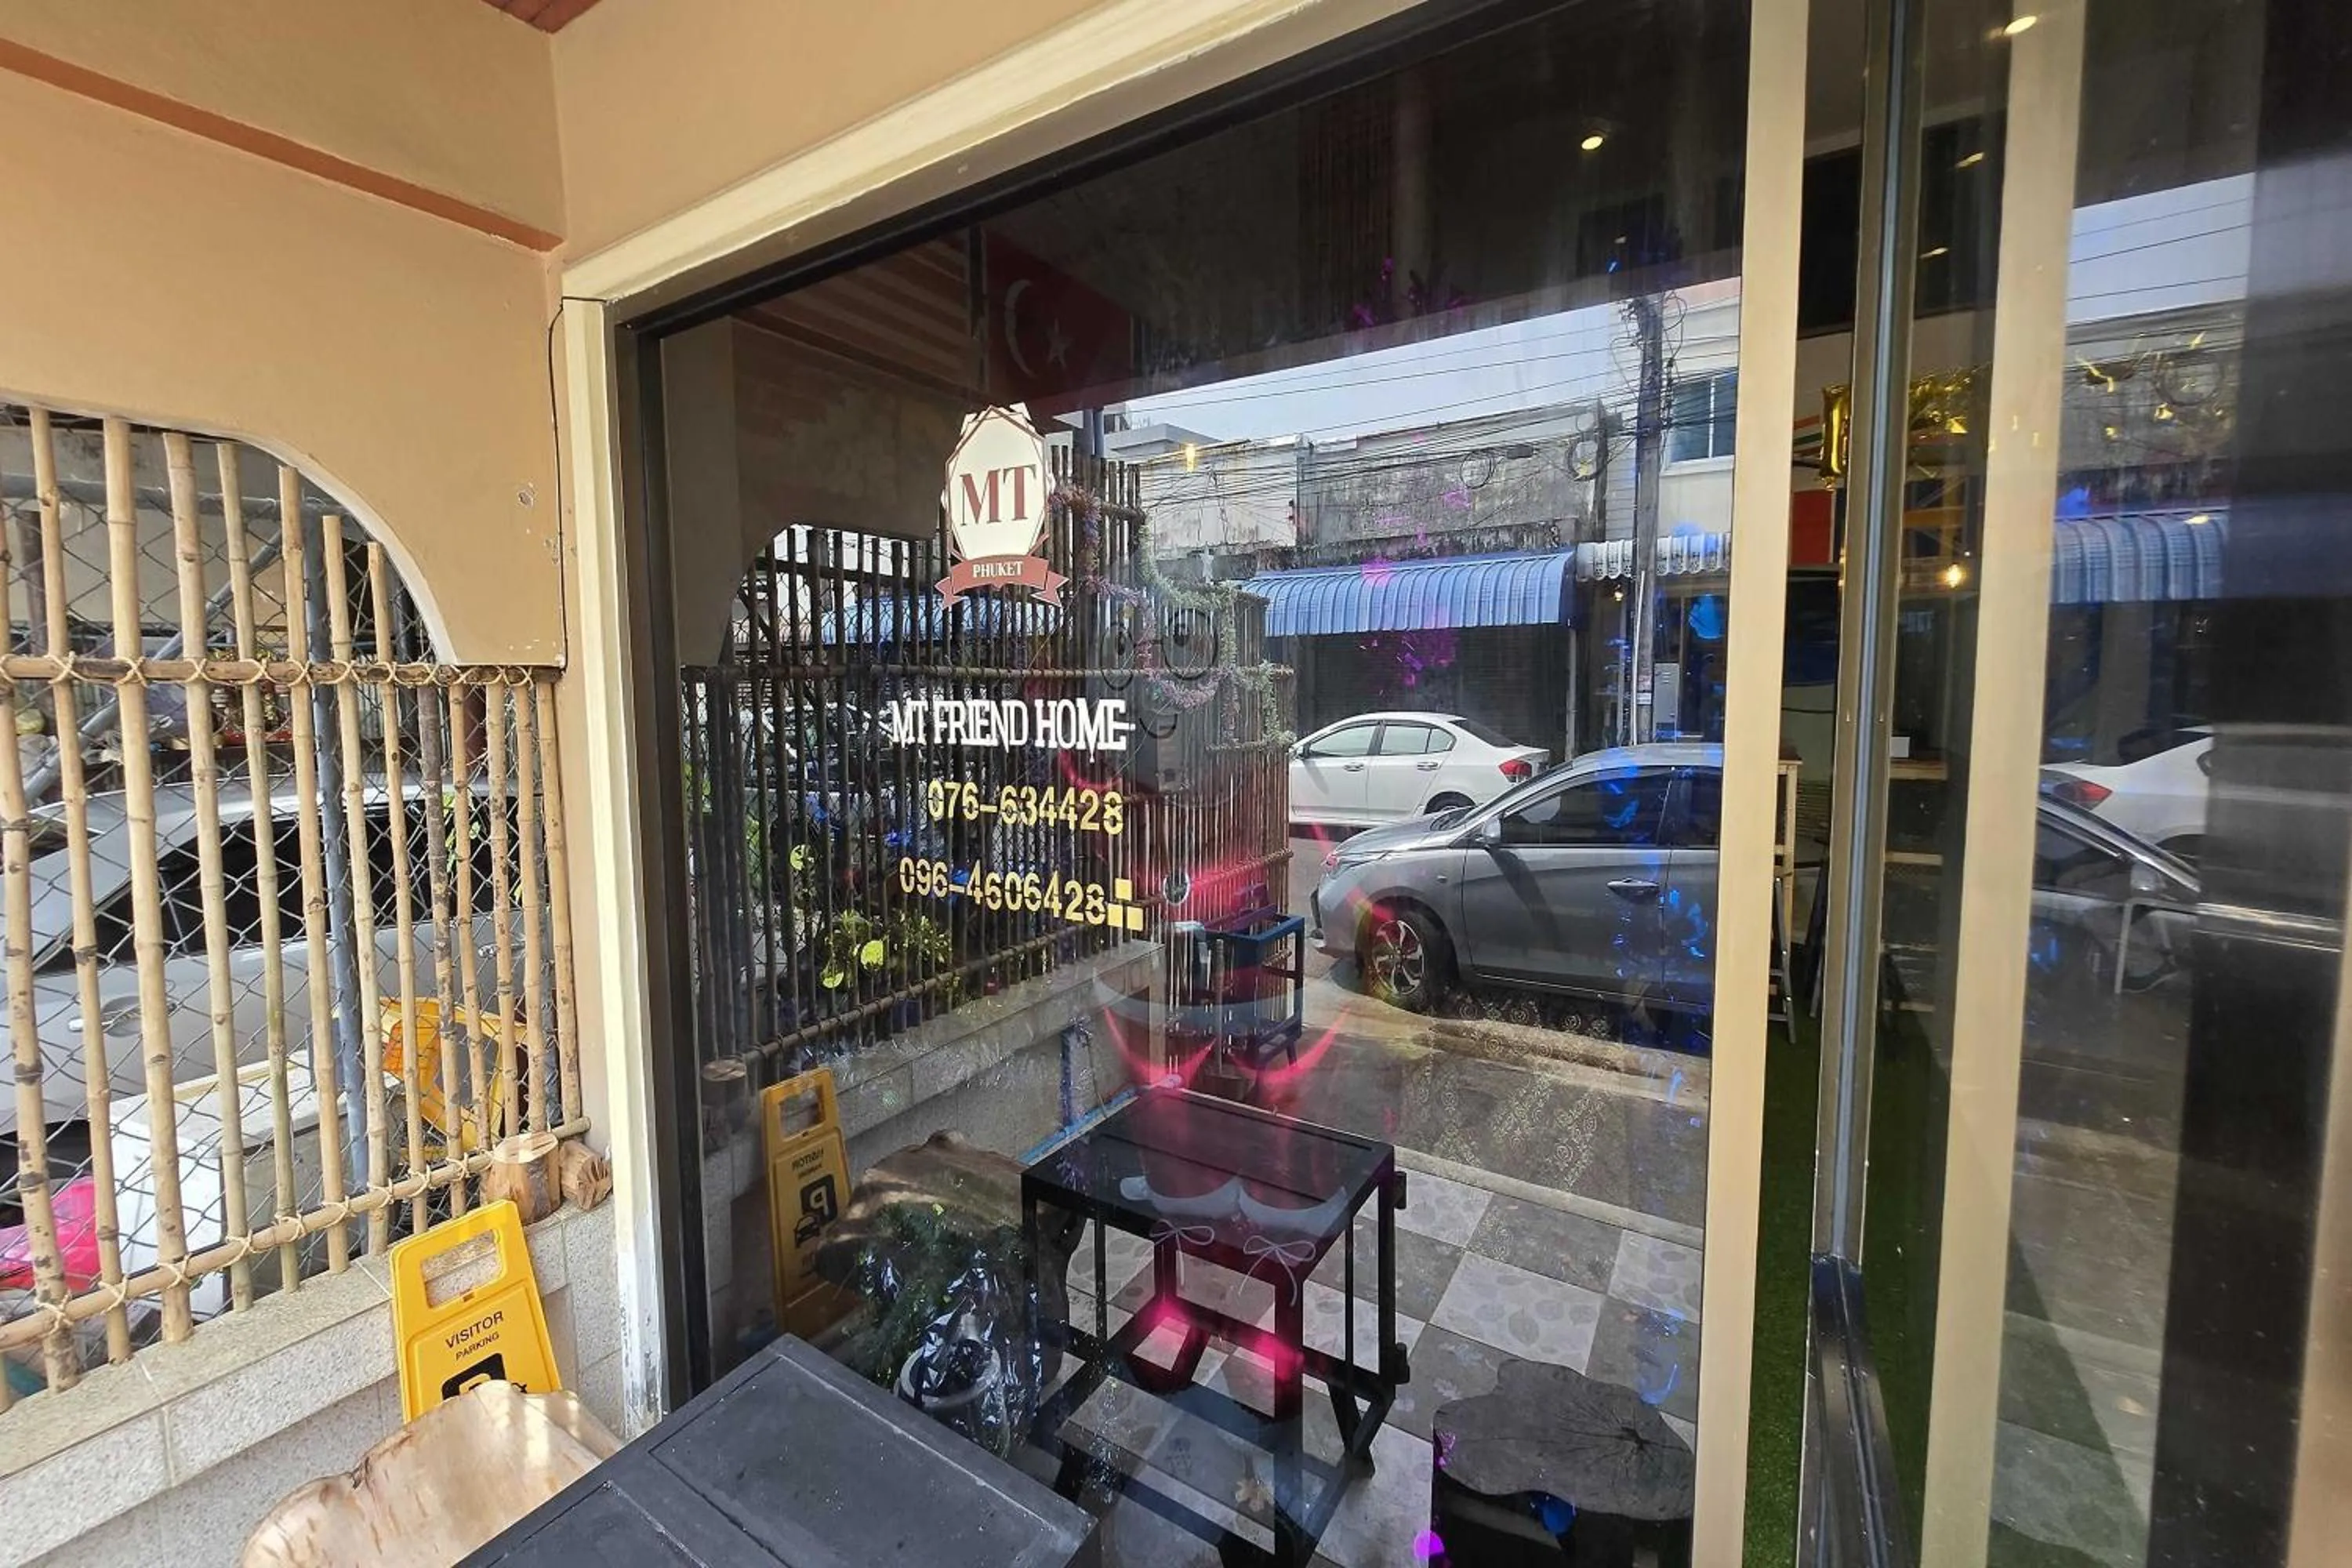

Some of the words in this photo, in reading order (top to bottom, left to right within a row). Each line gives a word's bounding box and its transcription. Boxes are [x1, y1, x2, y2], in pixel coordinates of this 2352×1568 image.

[959, 463, 1037, 526] MT
[972, 560, 1024, 578] PHUKET
[891, 699, 929, 748] MT
[933, 699, 1028, 753] FRIEND
[1033, 697, 1136, 764] HOME
[927, 778, 1123, 835] 076-634428
[899, 856, 1106, 926] 096-4606428
[445, 1310, 504, 1349] VISITOR
[456, 1331, 500, 1362] PARKING
